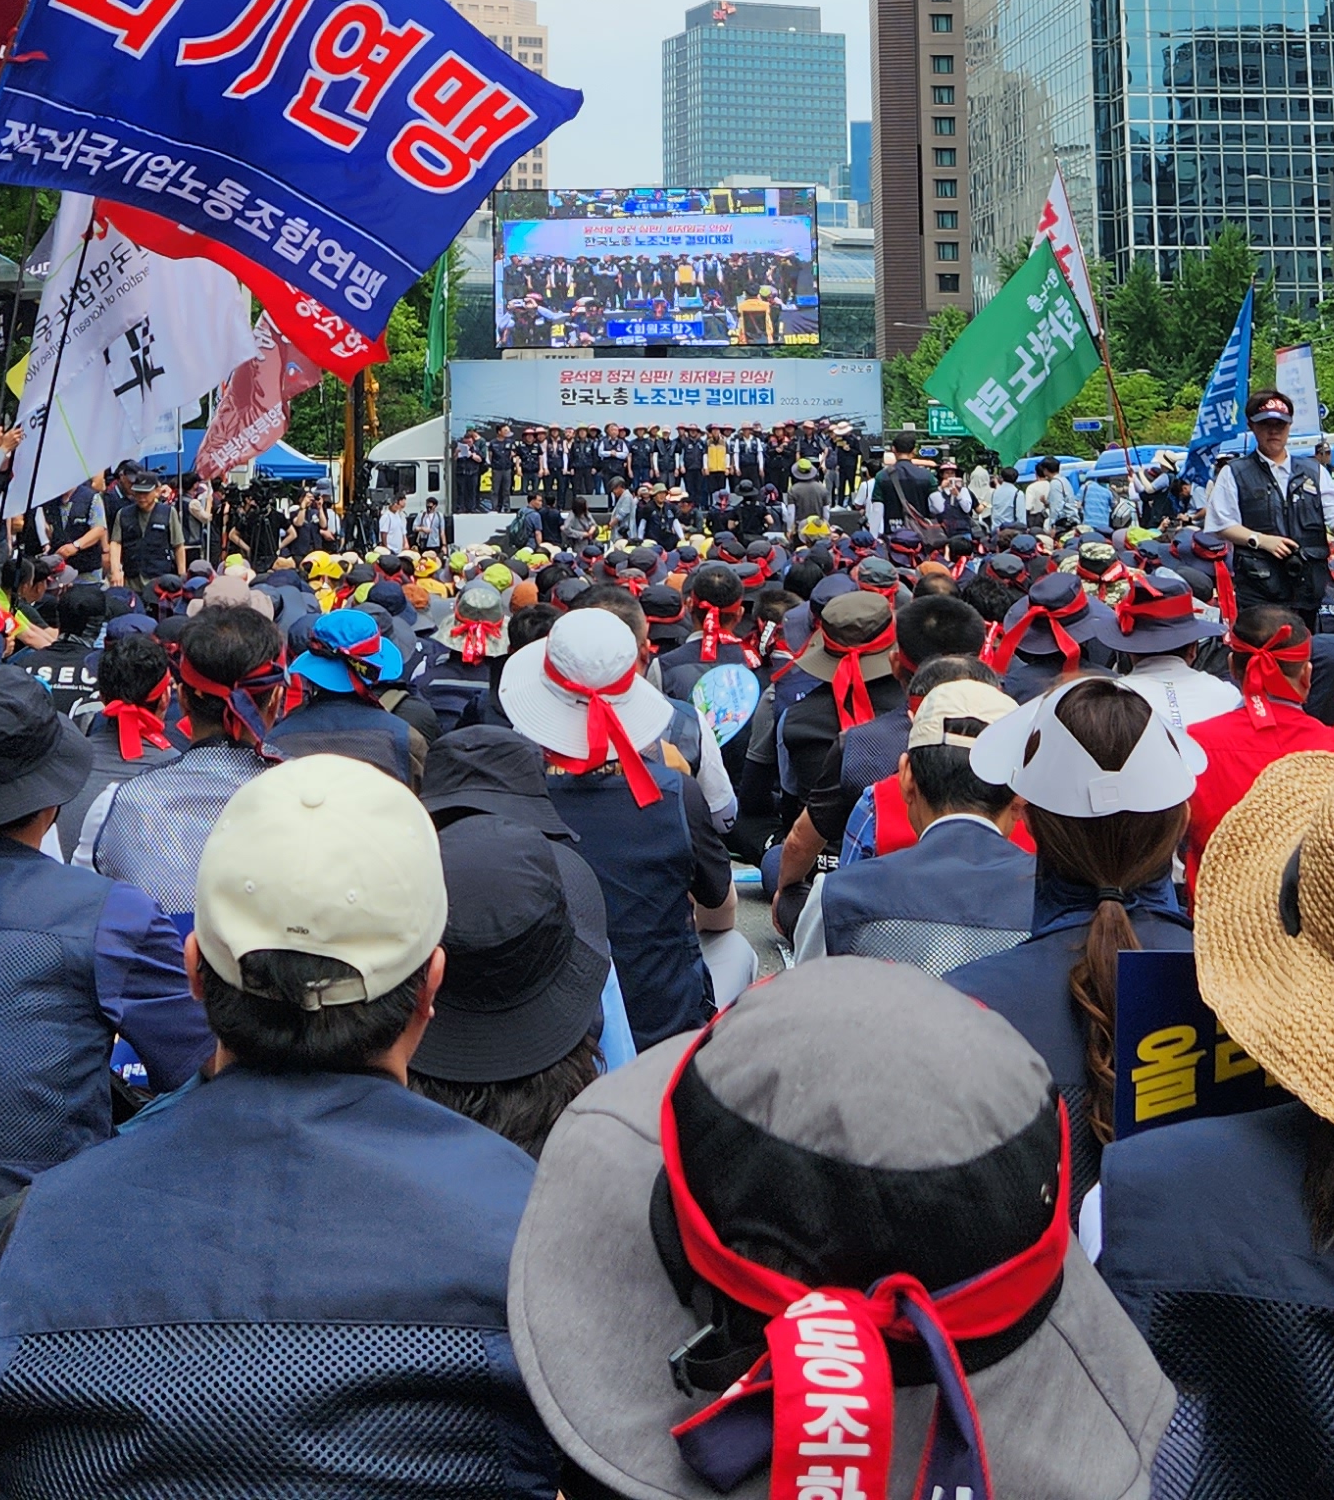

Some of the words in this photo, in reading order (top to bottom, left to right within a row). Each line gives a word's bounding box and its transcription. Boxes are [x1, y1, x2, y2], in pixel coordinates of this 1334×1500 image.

[584, 235, 632, 247] 한국노총
[635, 234, 683, 247] 노조간부
[685, 233, 734, 247] 결의대회
[559, 369, 604, 385] 윤석열
[606, 369, 636, 385] 정권
[639, 369, 674, 385] 심판!
[678, 369, 736, 385] 최저임금
[739, 369, 775, 385] 인상!
[841, 364, 873, 374] 한국노총
[560, 387, 630, 406] 한국노총
[632, 387, 701, 406] 노조간부
[704, 387, 775, 406] 결의대회
[816, 854, 840, 871] 전국
